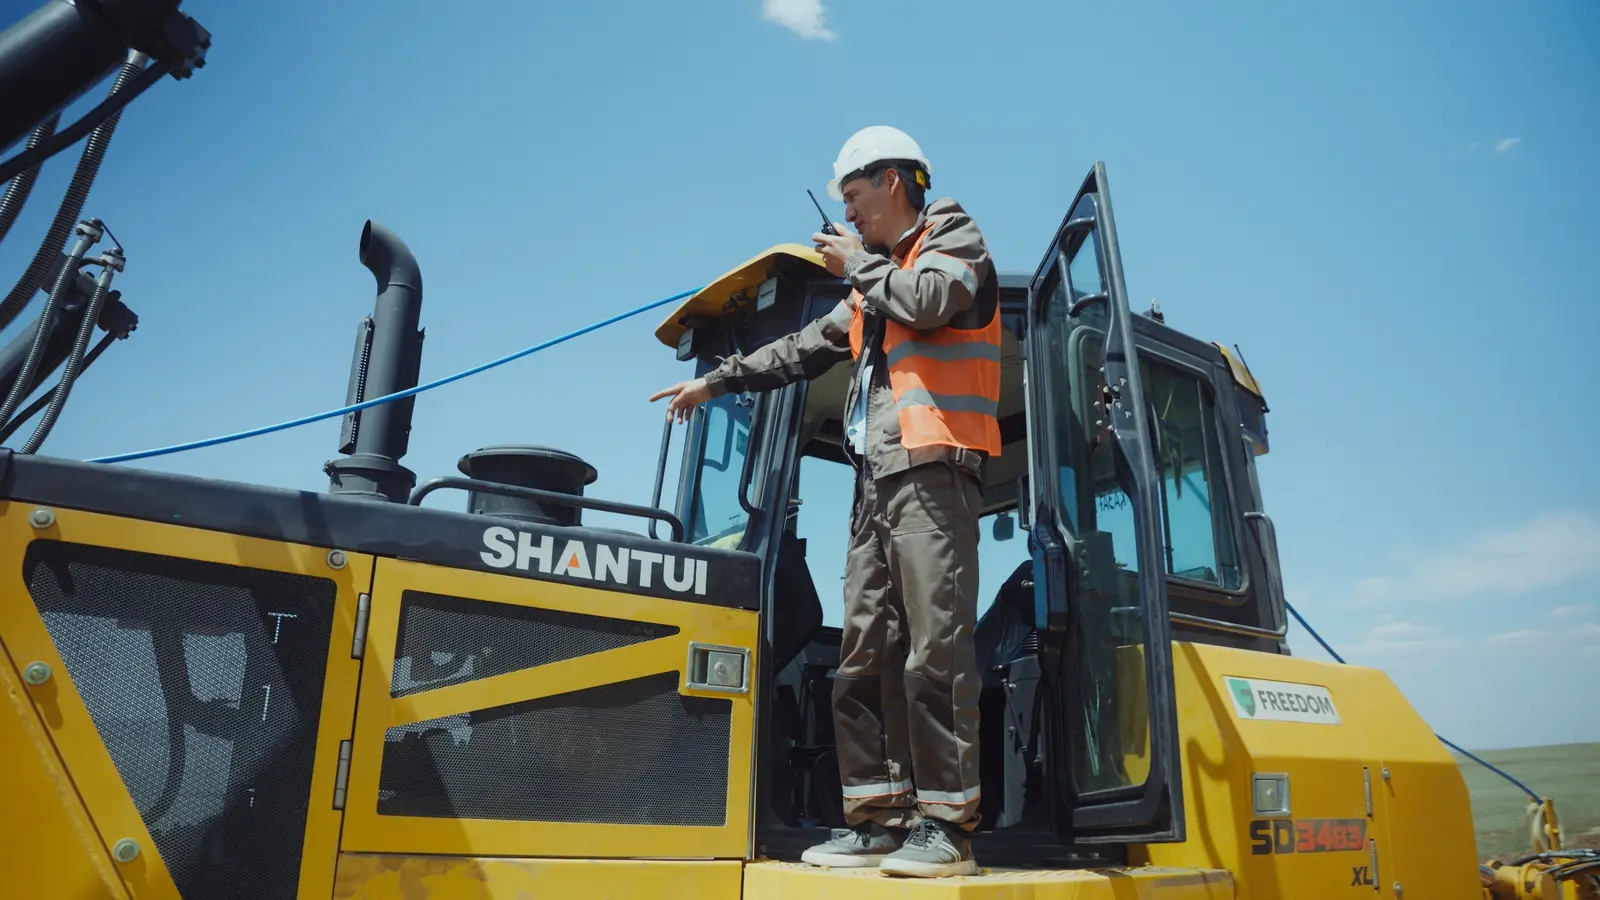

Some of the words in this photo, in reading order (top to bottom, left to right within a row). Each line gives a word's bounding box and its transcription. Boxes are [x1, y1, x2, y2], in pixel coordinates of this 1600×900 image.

[480, 526, 708, 596] SHANTUI
[1257, 690, 1336, 716] FREEDOM
[1351, 866, 1375, 887] XL
